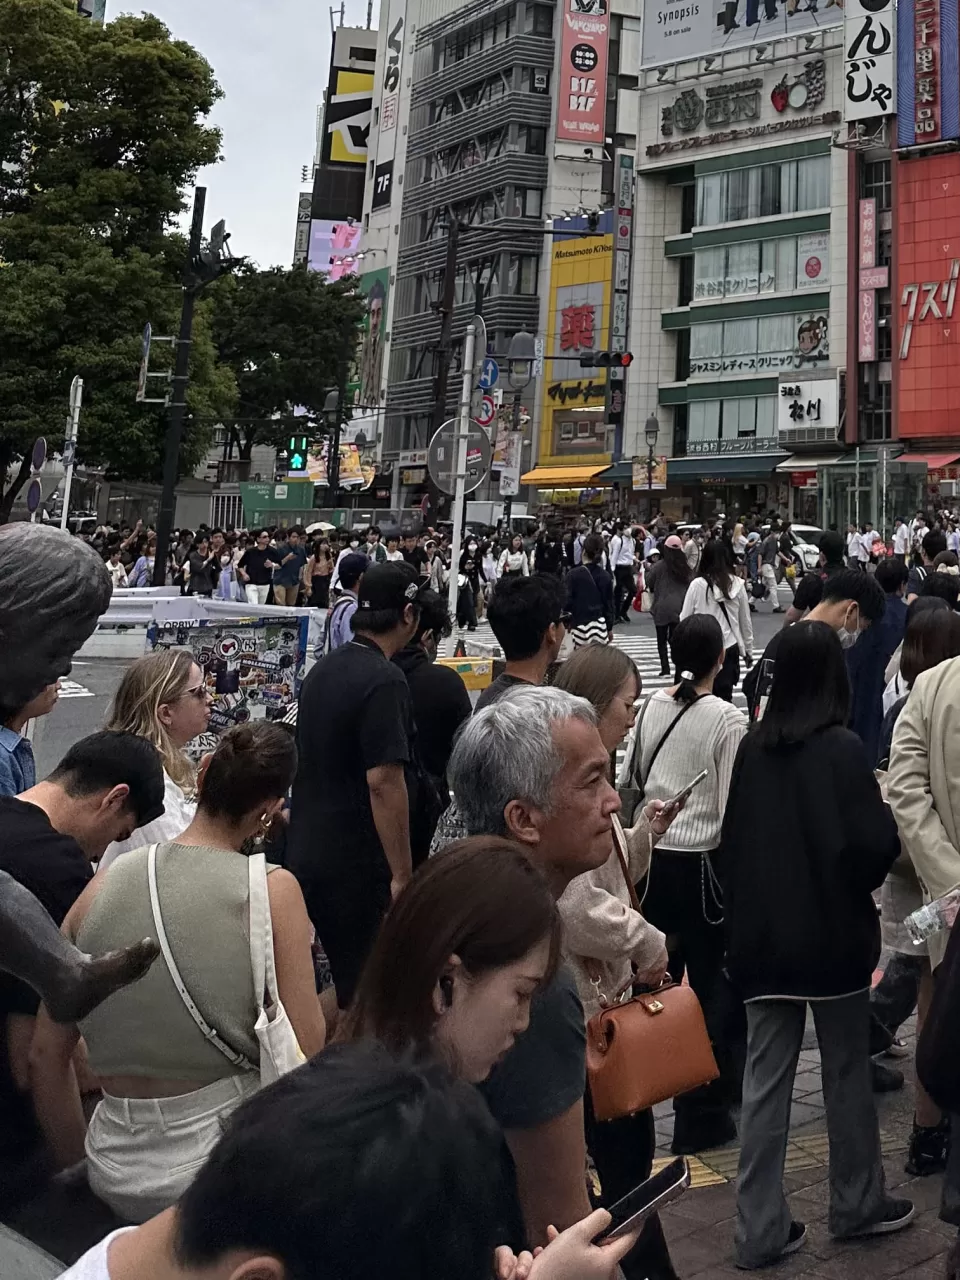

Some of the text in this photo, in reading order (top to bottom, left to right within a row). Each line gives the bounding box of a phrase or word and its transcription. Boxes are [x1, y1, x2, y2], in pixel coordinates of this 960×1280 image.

[657, 3, 700, 25] Synopsis
[571, 77, 596, 93] B1F
[376, 173, 391, 194] 7F
[555, 247, 593, 259] Matsumoto
[560, 303, 596, 352] 薬
